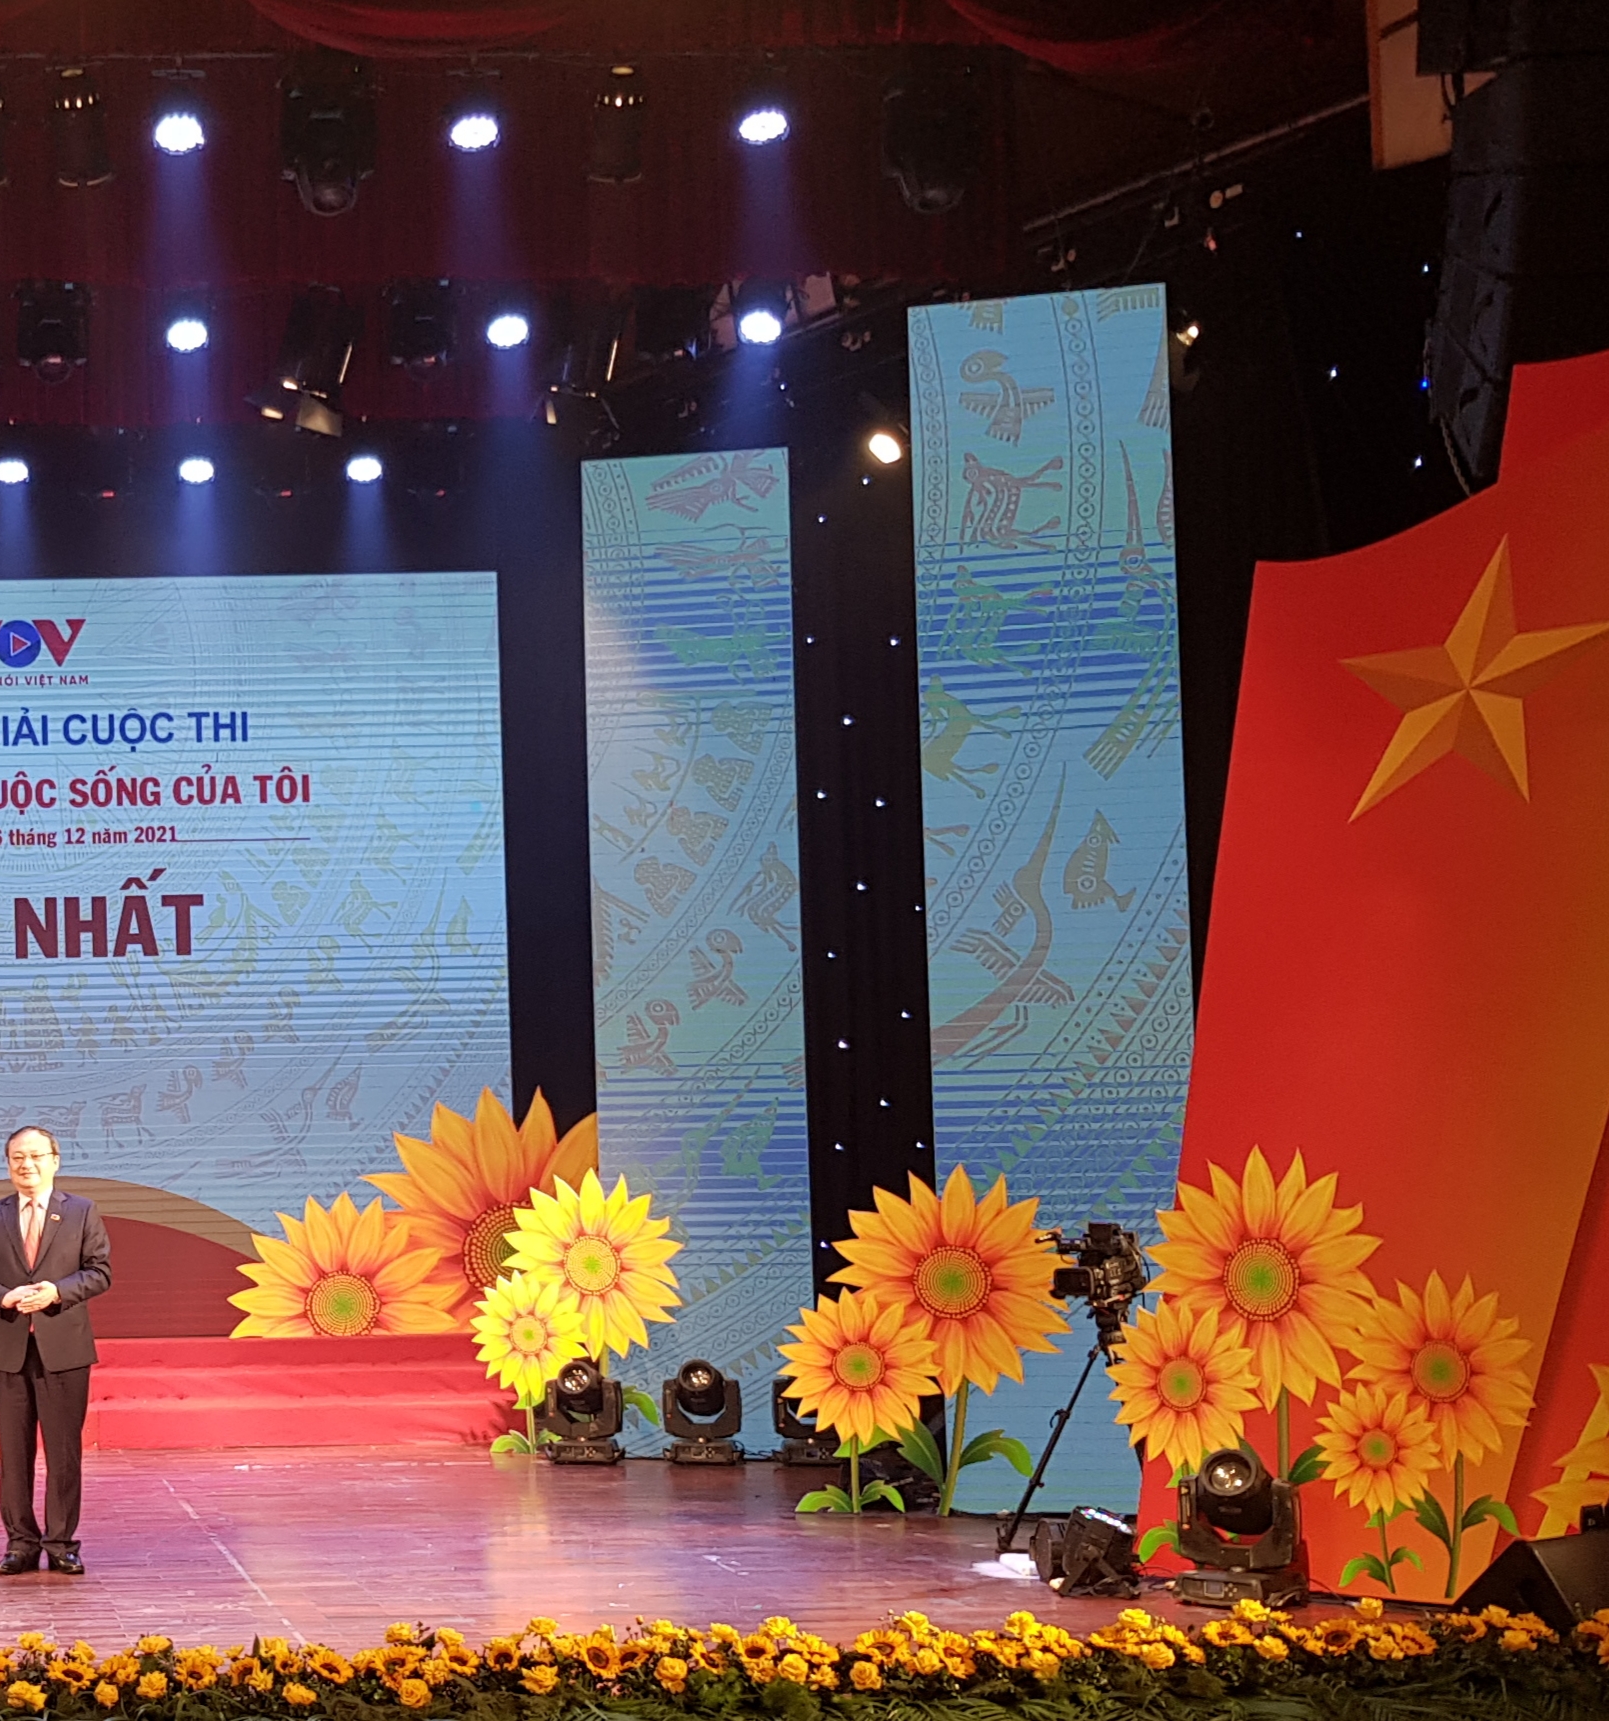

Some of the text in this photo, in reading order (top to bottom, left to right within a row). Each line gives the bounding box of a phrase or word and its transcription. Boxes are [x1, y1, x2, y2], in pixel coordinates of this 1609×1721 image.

[24, 673, 54, 688] VIỆT
[59, 675, 89, 686] NAM
[62, 708, 175, 752] CUỘC
[187, 711, 249, 743] THI
[68, 765, 161, 808] SỐNG
[172, 764, 242, 806] CỦA
[253, 766, 311, 804] TÔI
[8, 828, 57, 847] tháng
[64, 828, 86, 845] 12
[92, 828, 128, 844] năm
[134, 826, 177, 843] 2021
[14, 868, 204, 959] NHẤT
